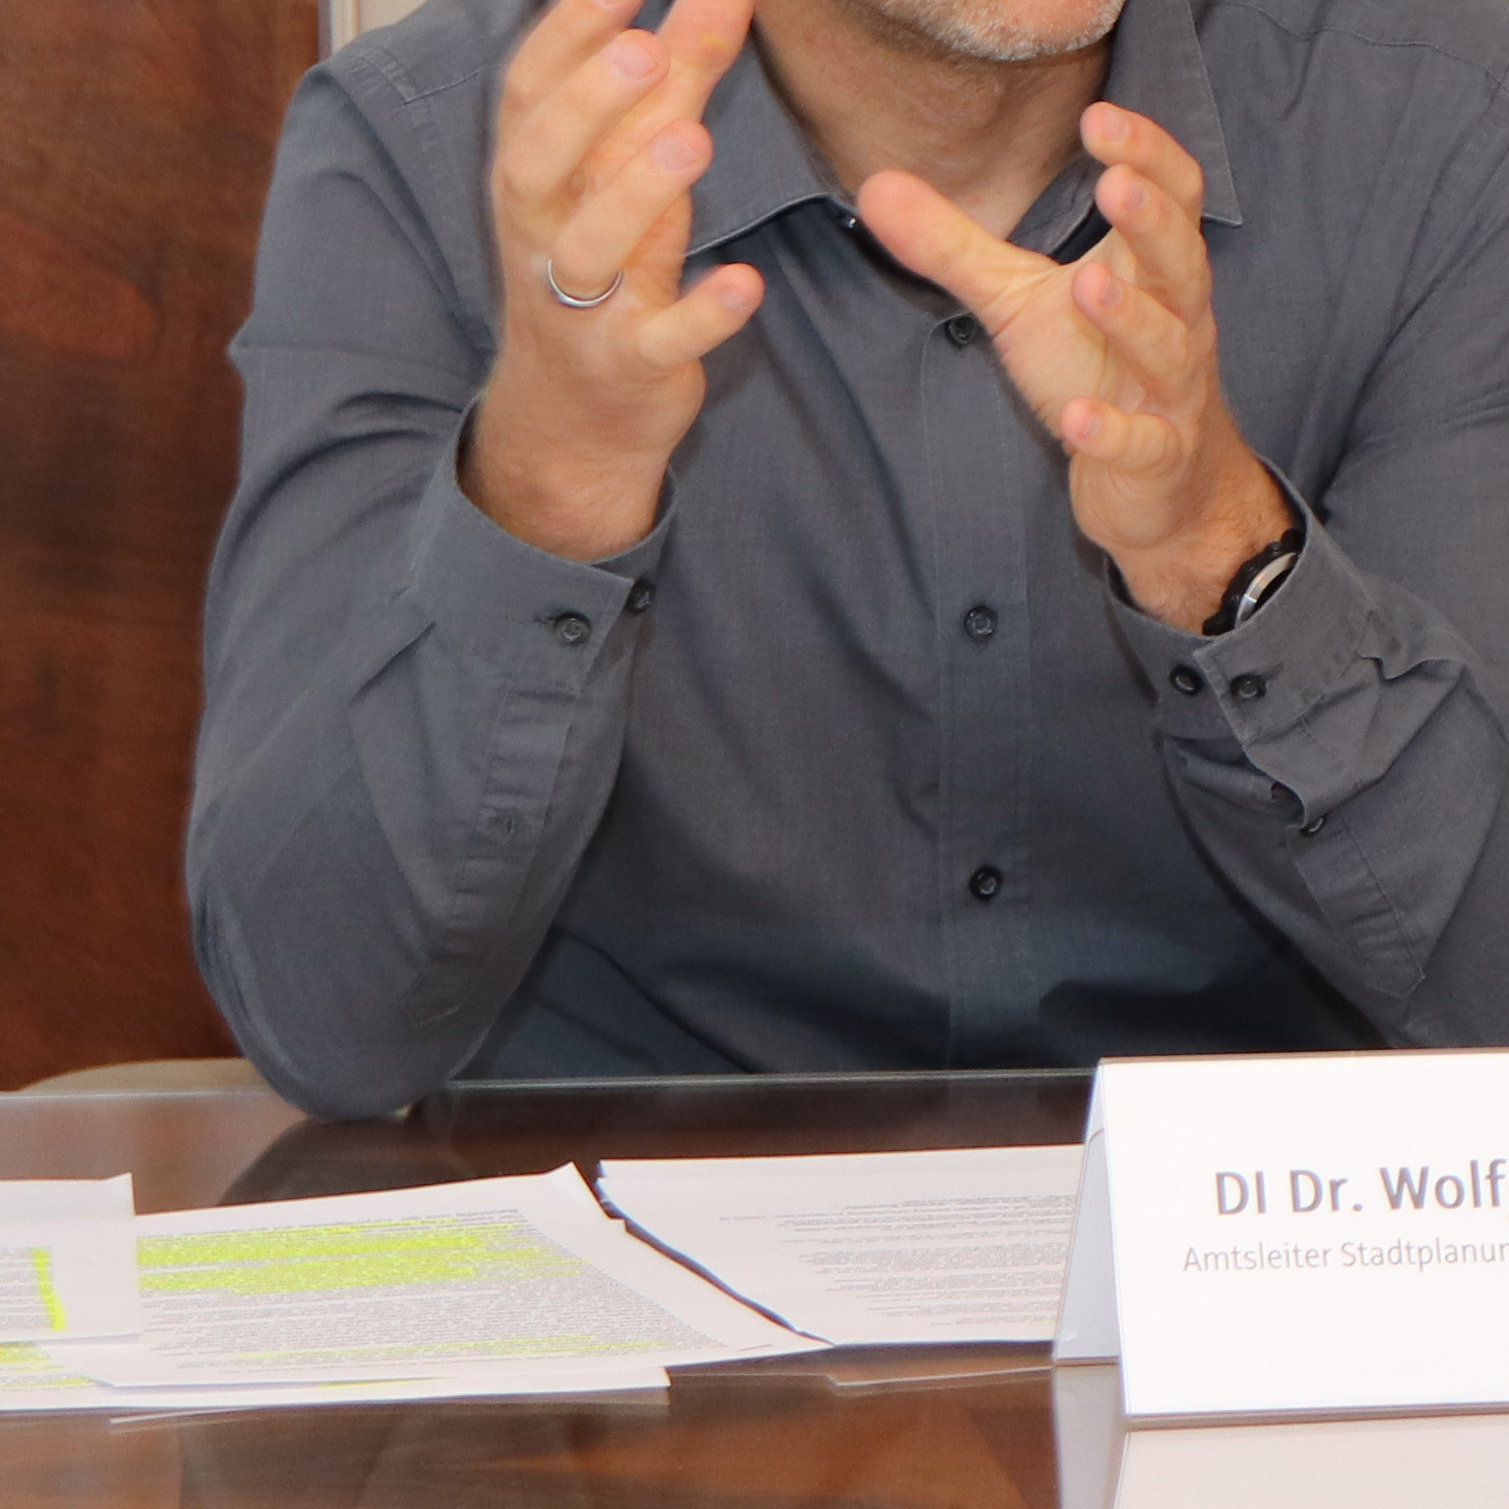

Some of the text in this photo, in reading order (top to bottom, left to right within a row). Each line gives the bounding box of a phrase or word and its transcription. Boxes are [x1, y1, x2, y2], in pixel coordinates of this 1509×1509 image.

[1215, 1169, 1267, 1215] DI
[1290, 1167, 1363, 1213] Dr.
[1183, 1240, 1332, 1272] Amtsleiter
